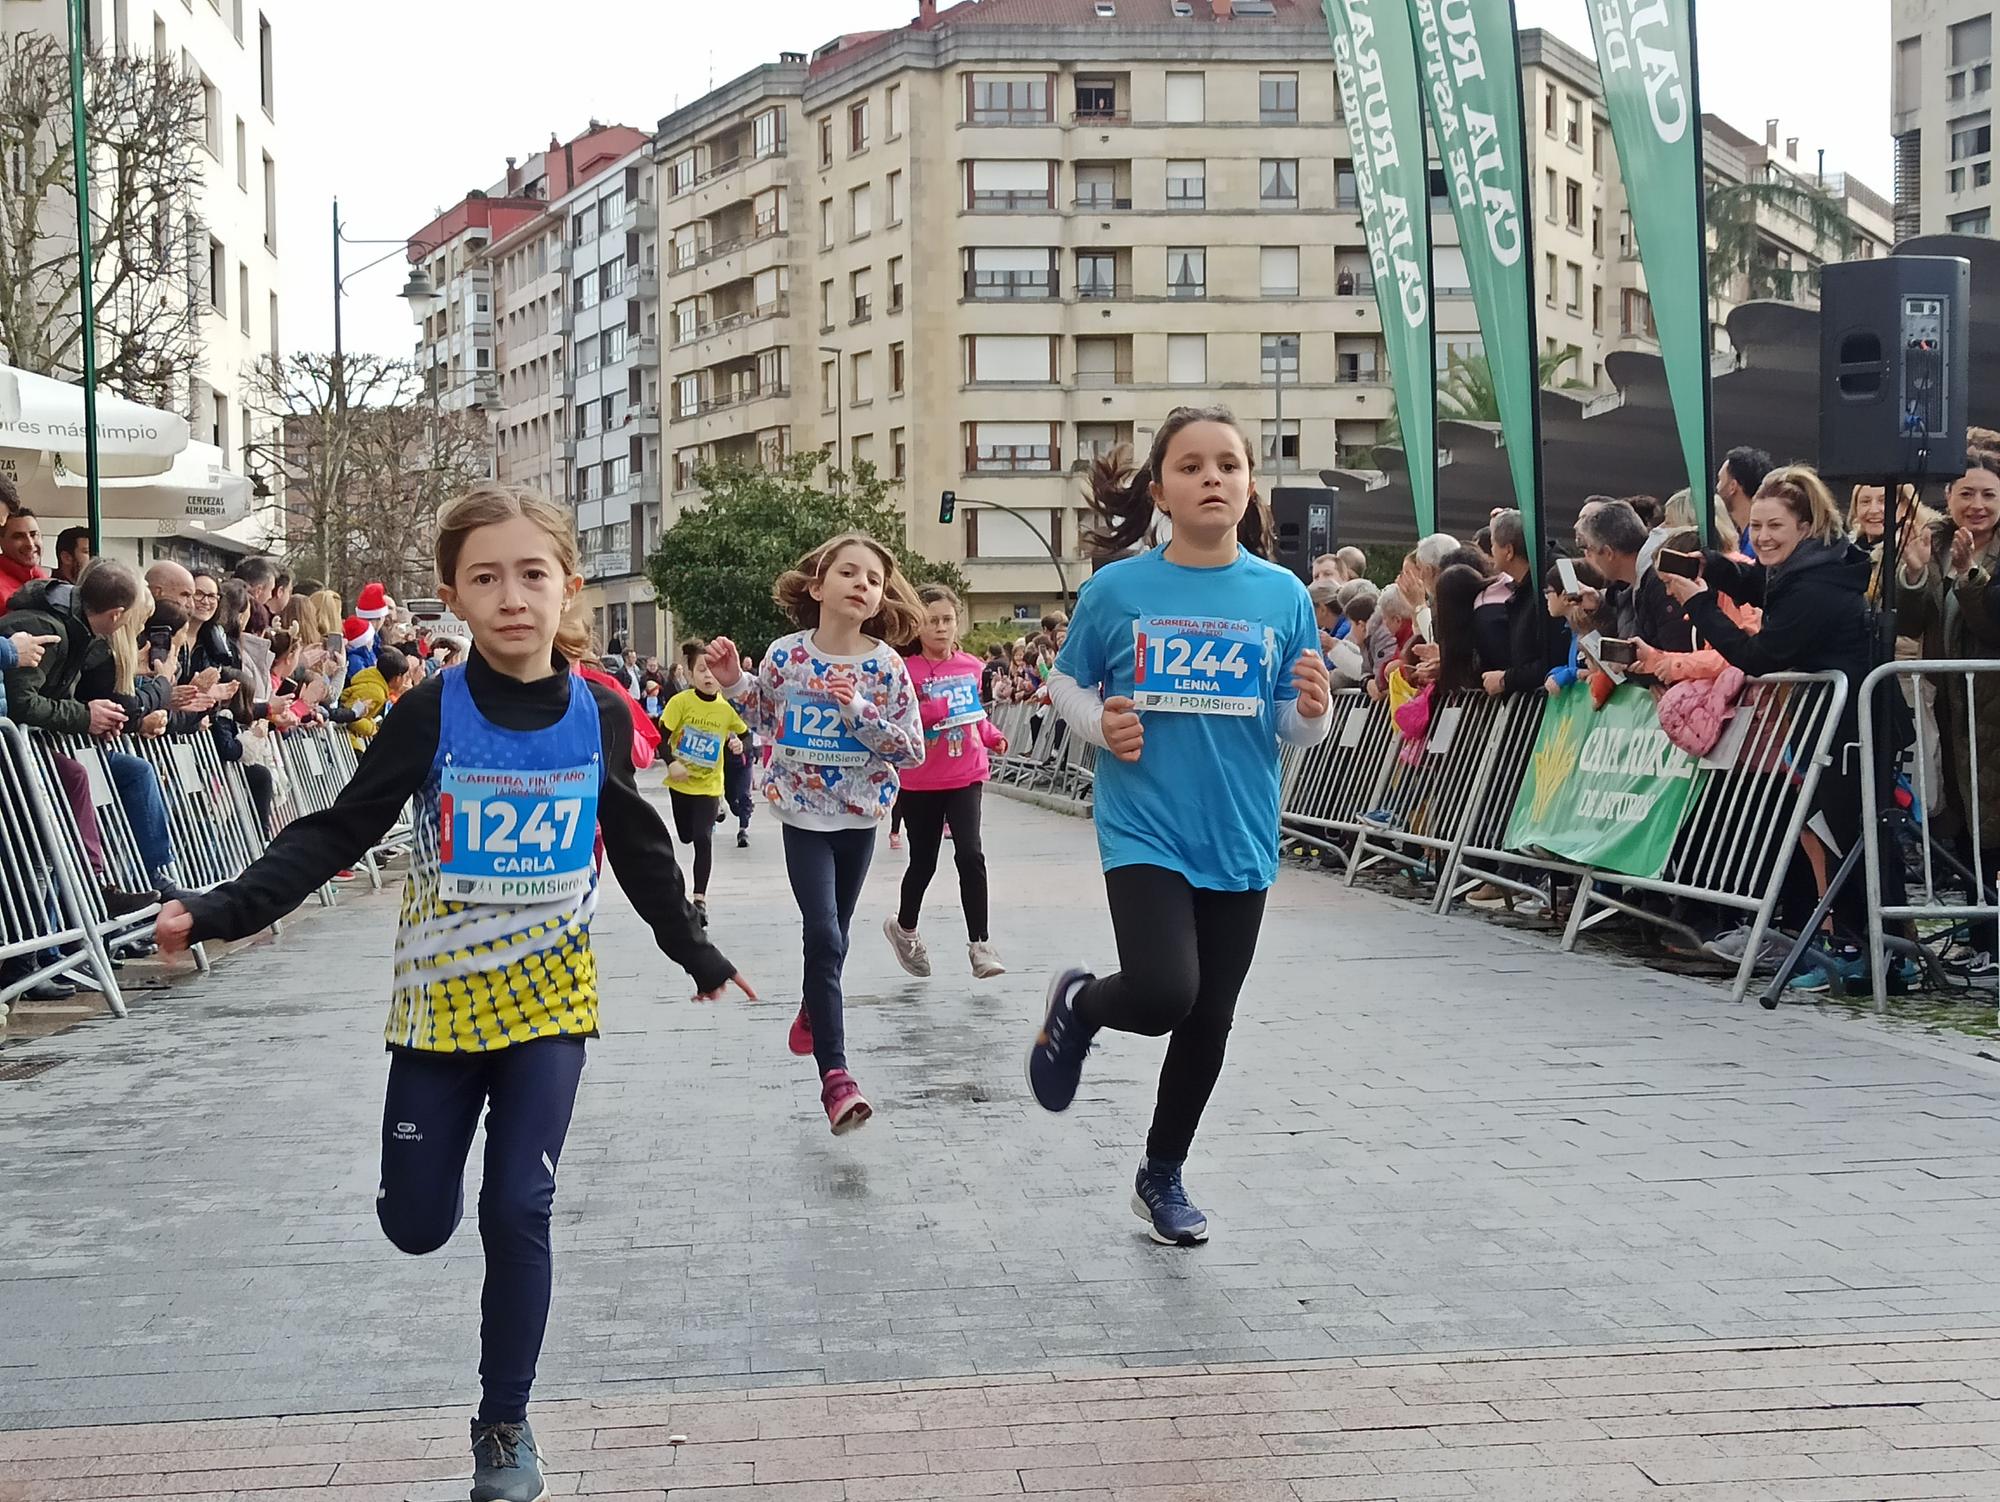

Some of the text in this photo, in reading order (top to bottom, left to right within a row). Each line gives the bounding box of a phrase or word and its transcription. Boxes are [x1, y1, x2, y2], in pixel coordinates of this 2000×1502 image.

[48, 422, 86, 437] más
[96, 424, 158, 442] limpio
[187, 495, 225, 506] CERVEZAS
[185, 506, 226, 516] ALHAMBRA
[1150, 618, 1199, 629] CARRERA
[1150, 638, 1248, 679] 1244
[1174, 678, 1221, 692] LENNA
[1179, 697, 1245, 711] PDMSiero
[790, 704, 852, 738] 122
[685, 734, 715, 755] 1154
[807, 737, 839, 749] NORA
[808, 751, 861, 763] PDMSiero
[457, 774, 524, 787] CARRERA
[528, 776, 546, 787] FIN
[461, 798, 582, 853] 1247
[493, 855, 555, 873] CARLA
